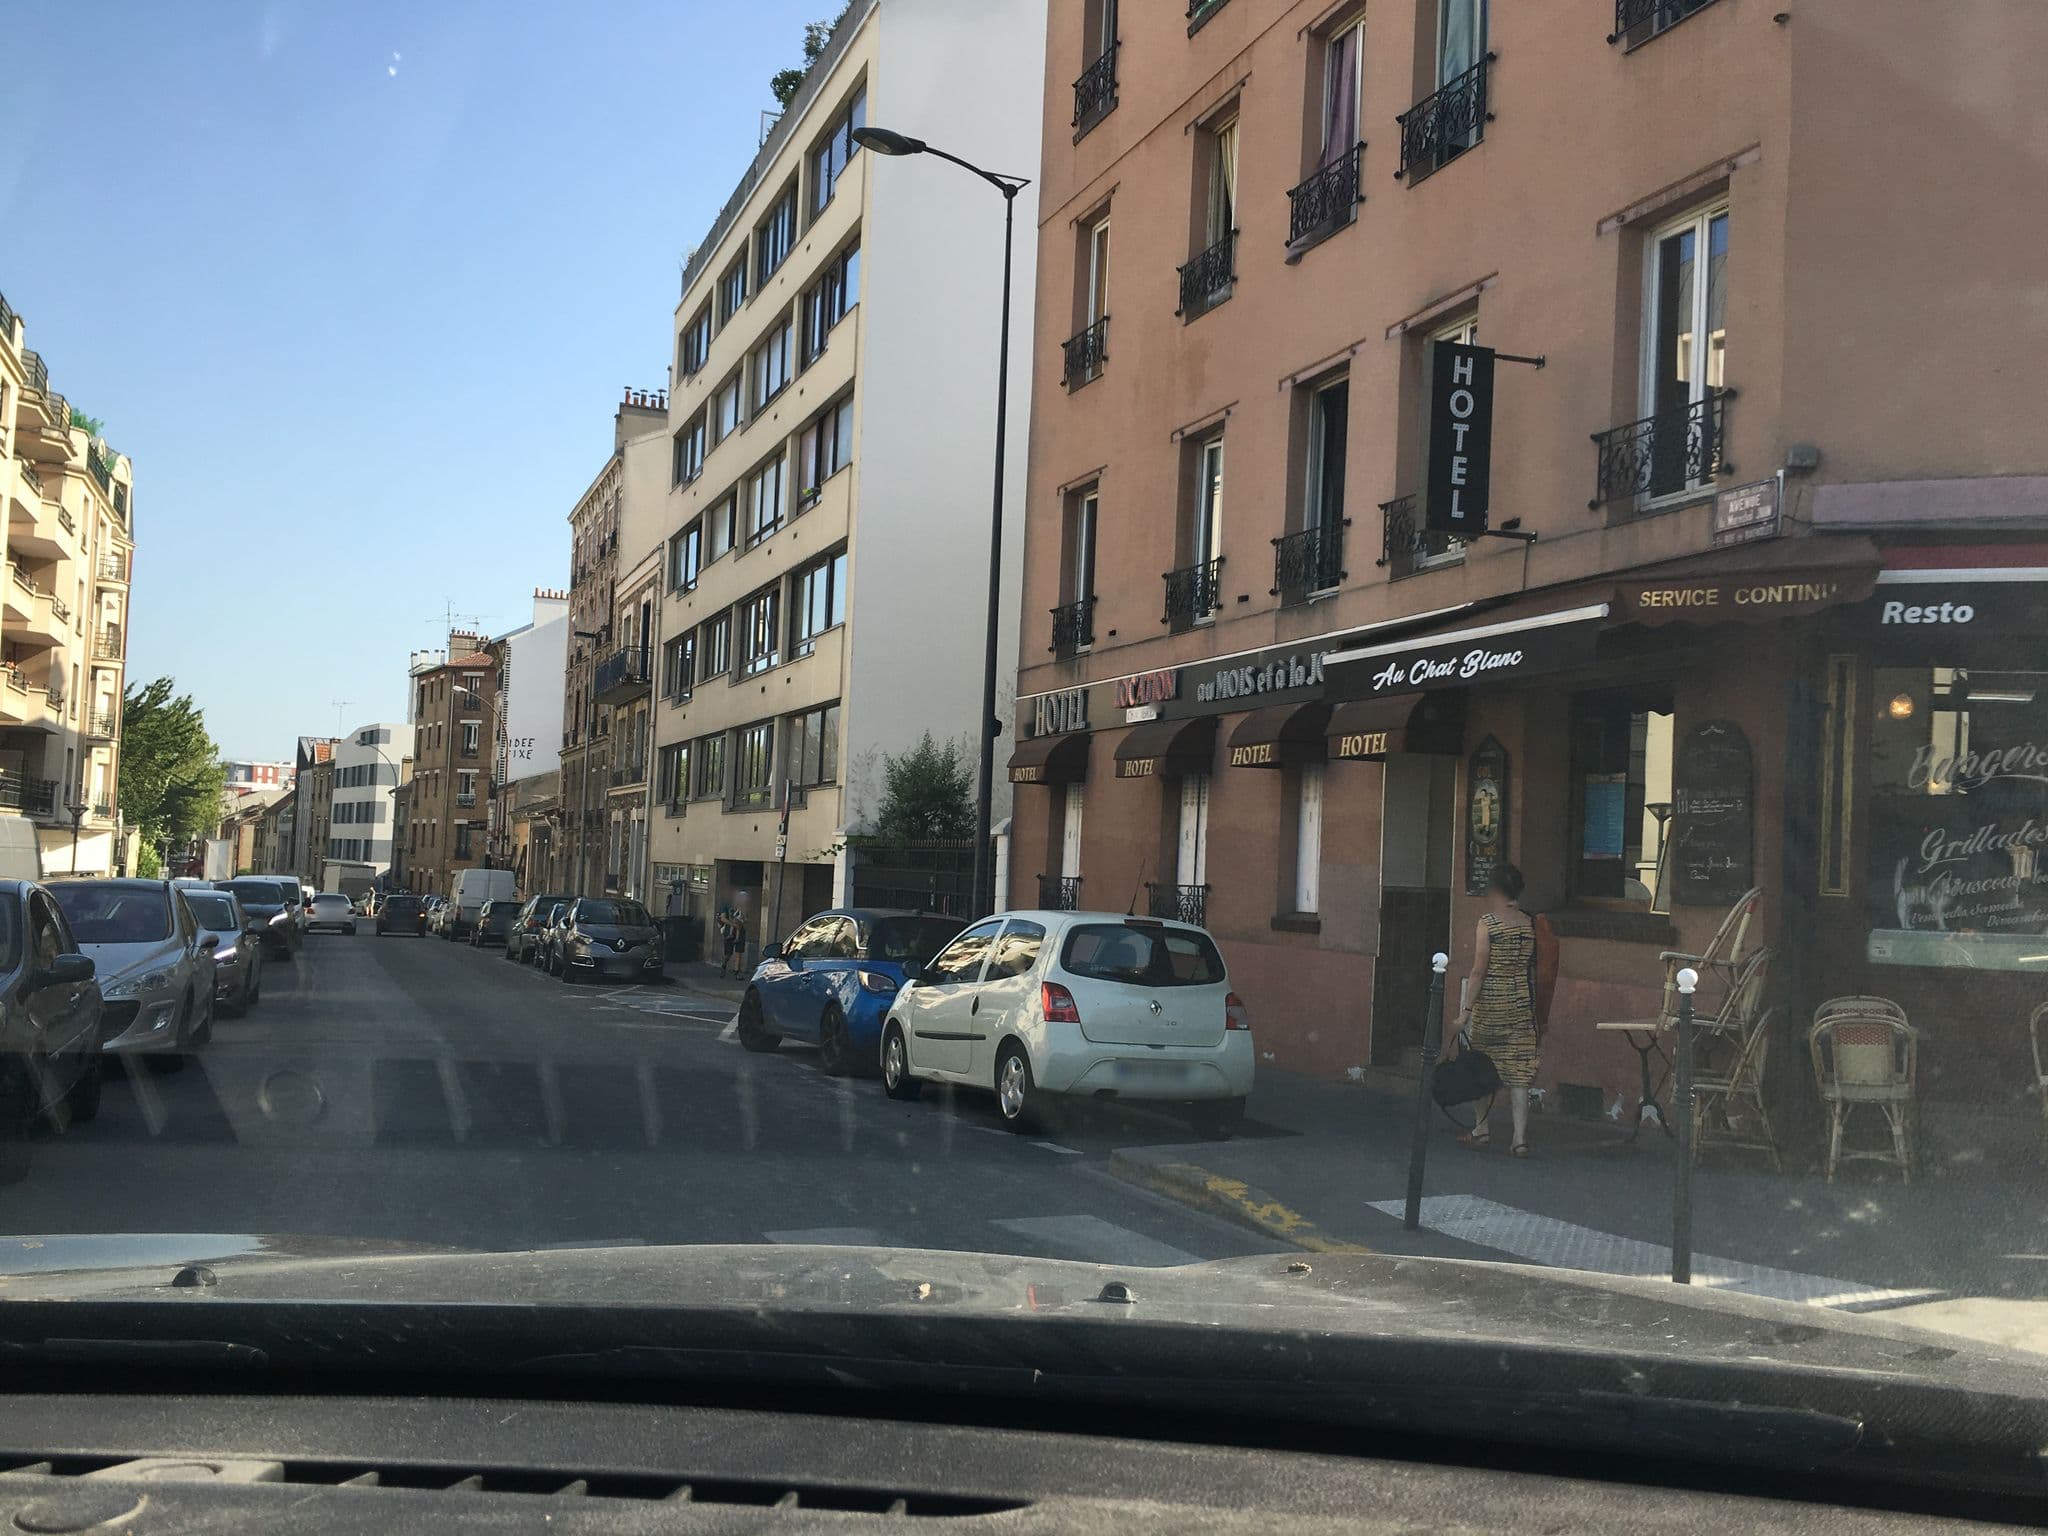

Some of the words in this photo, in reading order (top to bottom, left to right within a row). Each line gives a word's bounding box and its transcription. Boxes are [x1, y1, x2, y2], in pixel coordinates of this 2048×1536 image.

[1449, 354, 1475, 519] HOTEL
[1638, 588, 1719, 607] SERVICE
[1881, 600, 1975, 625] Resto
[1372, 662, 1405, 691] Au
[1408, 655, 1456, 685] Chat
[1458, 649, 1524, 679] Blanc
[1215, 665, 1254, 700] MOIS
[1033, 689, 1087, 737] HOTEL
[509, 737, 535, 748] IDEE
[1340, 733, 1388, 757] HOTEL
[508, 749, 534, 760] IXE
[1231, 744, 1272, 765] HOTEL
[1013, 767, 1038, 782] HOTEL
[1124, 759, 1154, 777] HOTEL
